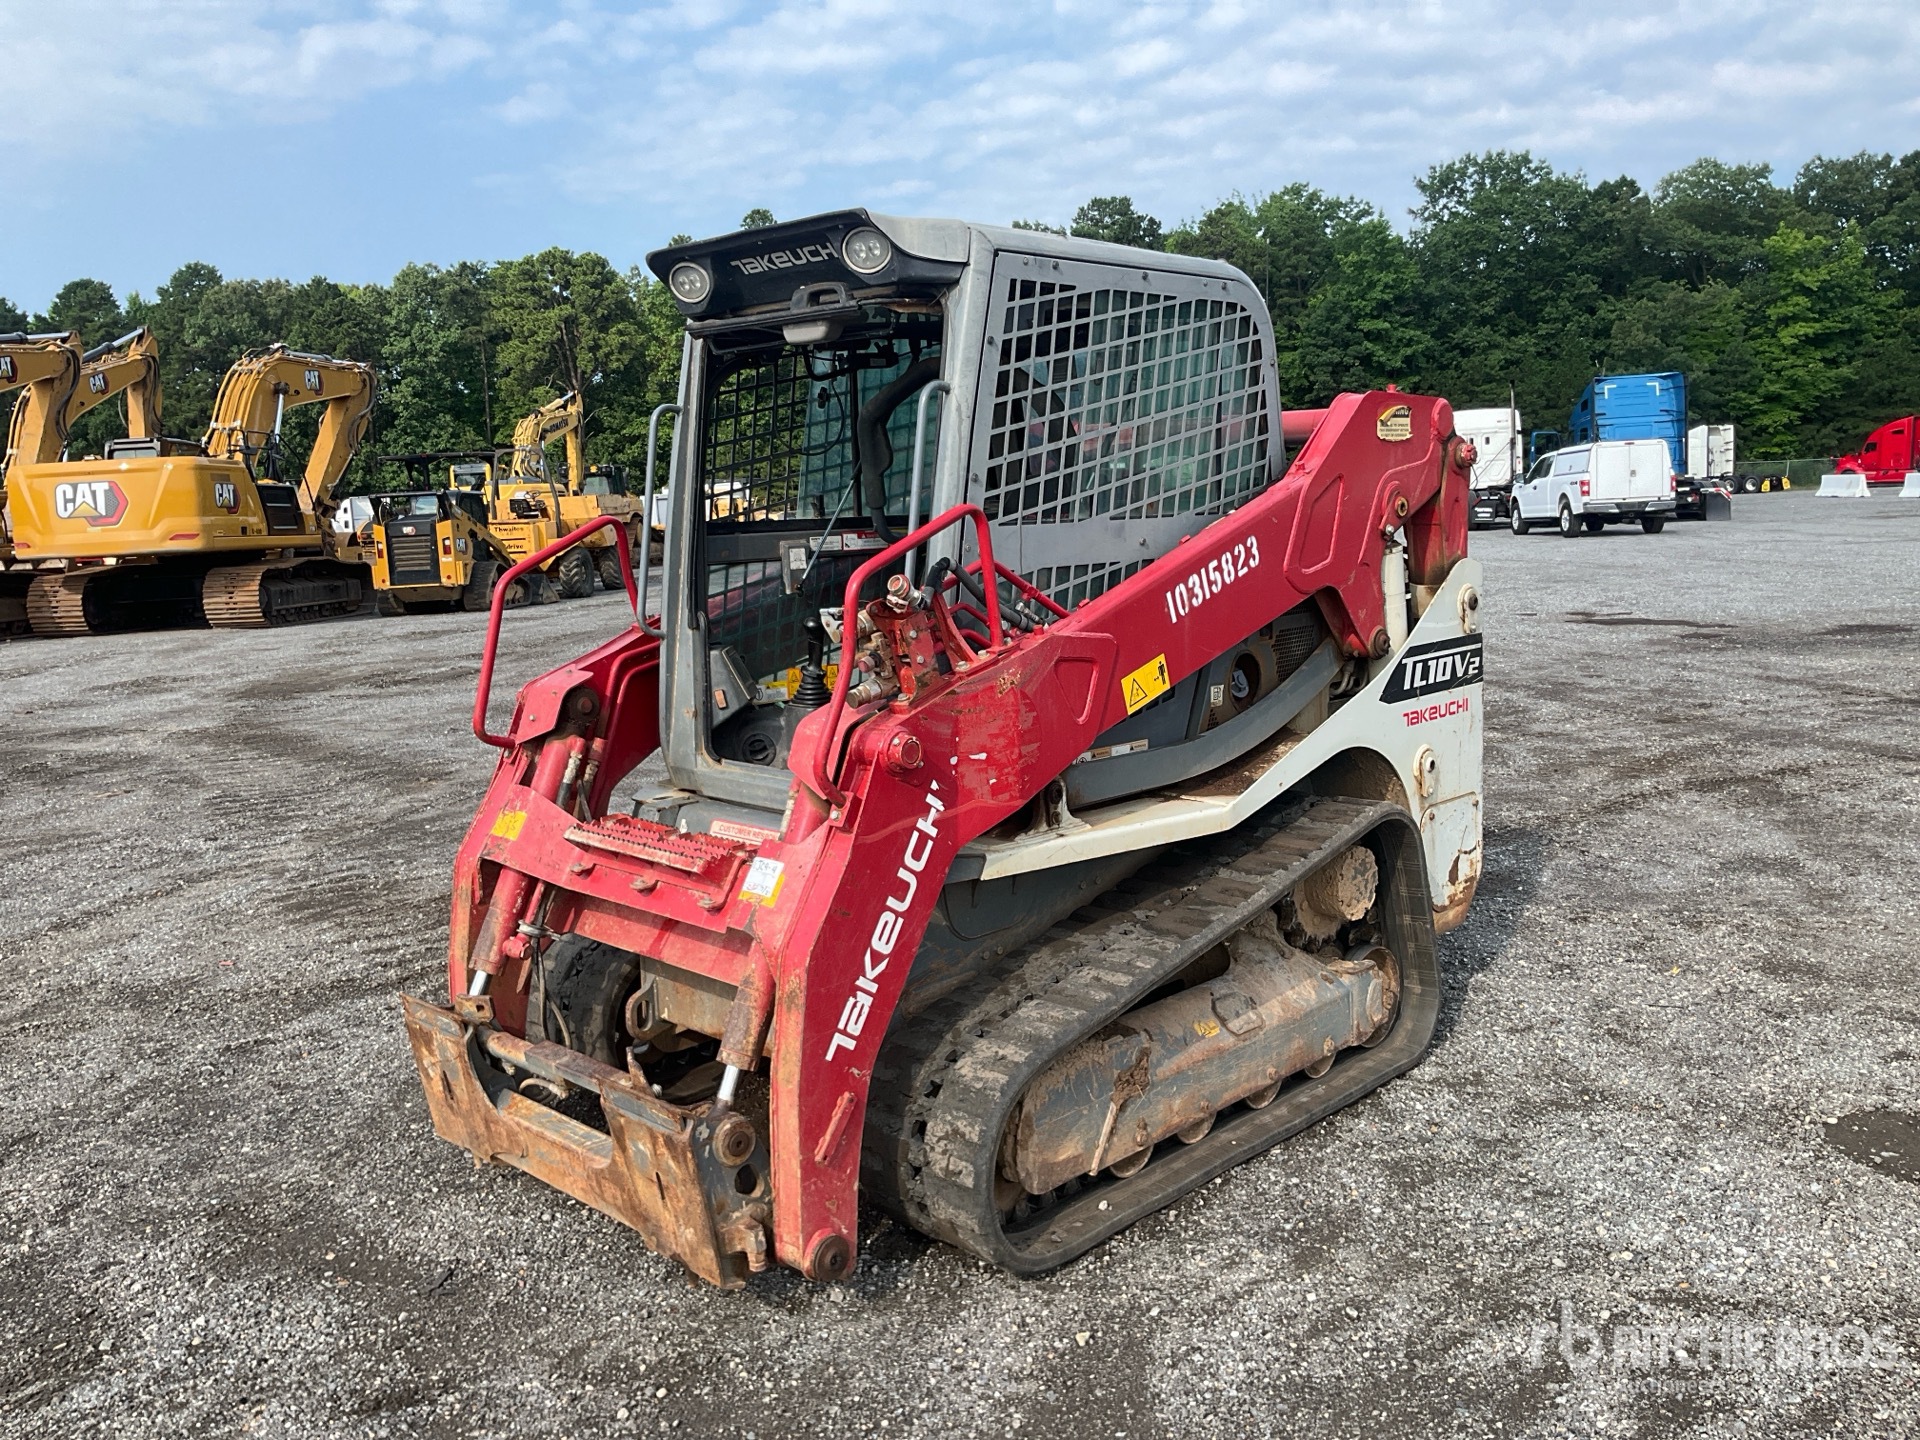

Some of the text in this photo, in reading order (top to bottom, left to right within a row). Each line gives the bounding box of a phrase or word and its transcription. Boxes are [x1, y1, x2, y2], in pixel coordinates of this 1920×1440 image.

[89, 373, 105, 393] CAT
[305, 370, 320, 390] CAT
[55, 481, 110, 519] CAT
[214, 483, 235, 507] CAT
[456, 538, 466, 552] CAT
[1165, 535, 1260, 624] 10315823
[1401, 643, 1482, 690] TL10V2
[1402, 698, 1469, 727] TAKEUCHI
[719, 824, 753, 837] CUSTOMER
